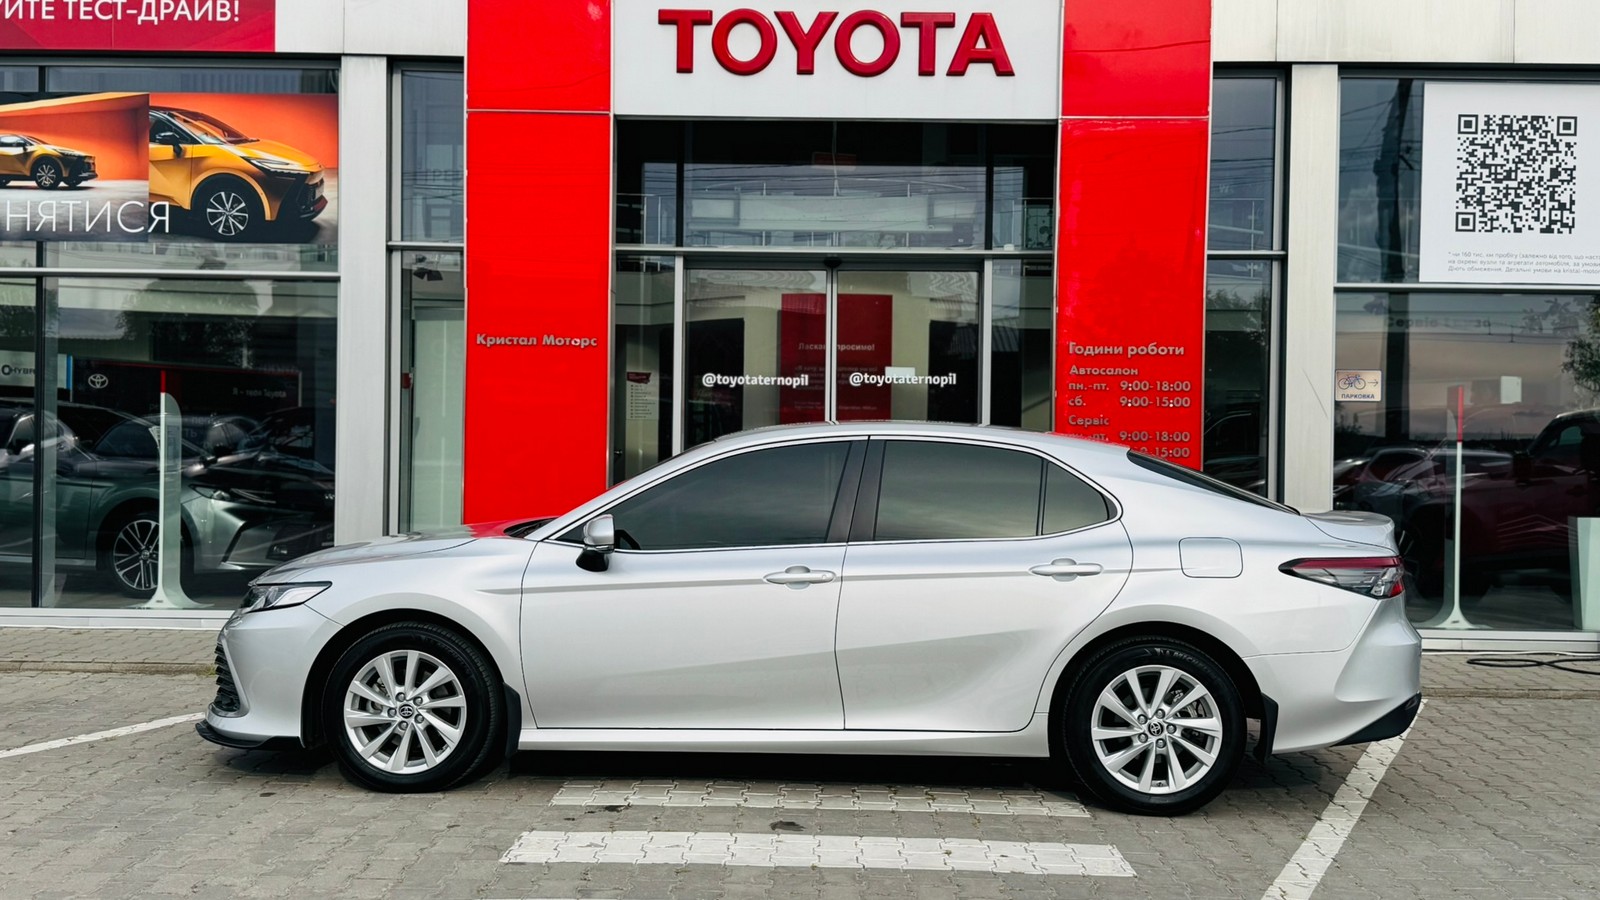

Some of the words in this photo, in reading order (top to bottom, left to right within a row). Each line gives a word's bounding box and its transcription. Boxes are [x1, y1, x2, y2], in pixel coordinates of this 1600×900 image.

[658, 8, 1015, 77] TOYOTA
[6, 200, 170, 233] НЯТИСЯ
[476, 333, 537, 347] Кристал
[542, 334, 597, 348] Моторс
[1069, 341, 1123, 356] Години
[1128, 342, 1184, 358] роботи
[1069, 364, 1138, 376] Автосалон
[702, 373, 809, 388] @toyotaternopil
[849, 371, 957, 387] @toyotaternopil
[1068, 395, 1087, 406] сб.
[1068, 414, 1110, 428] Сервіс
